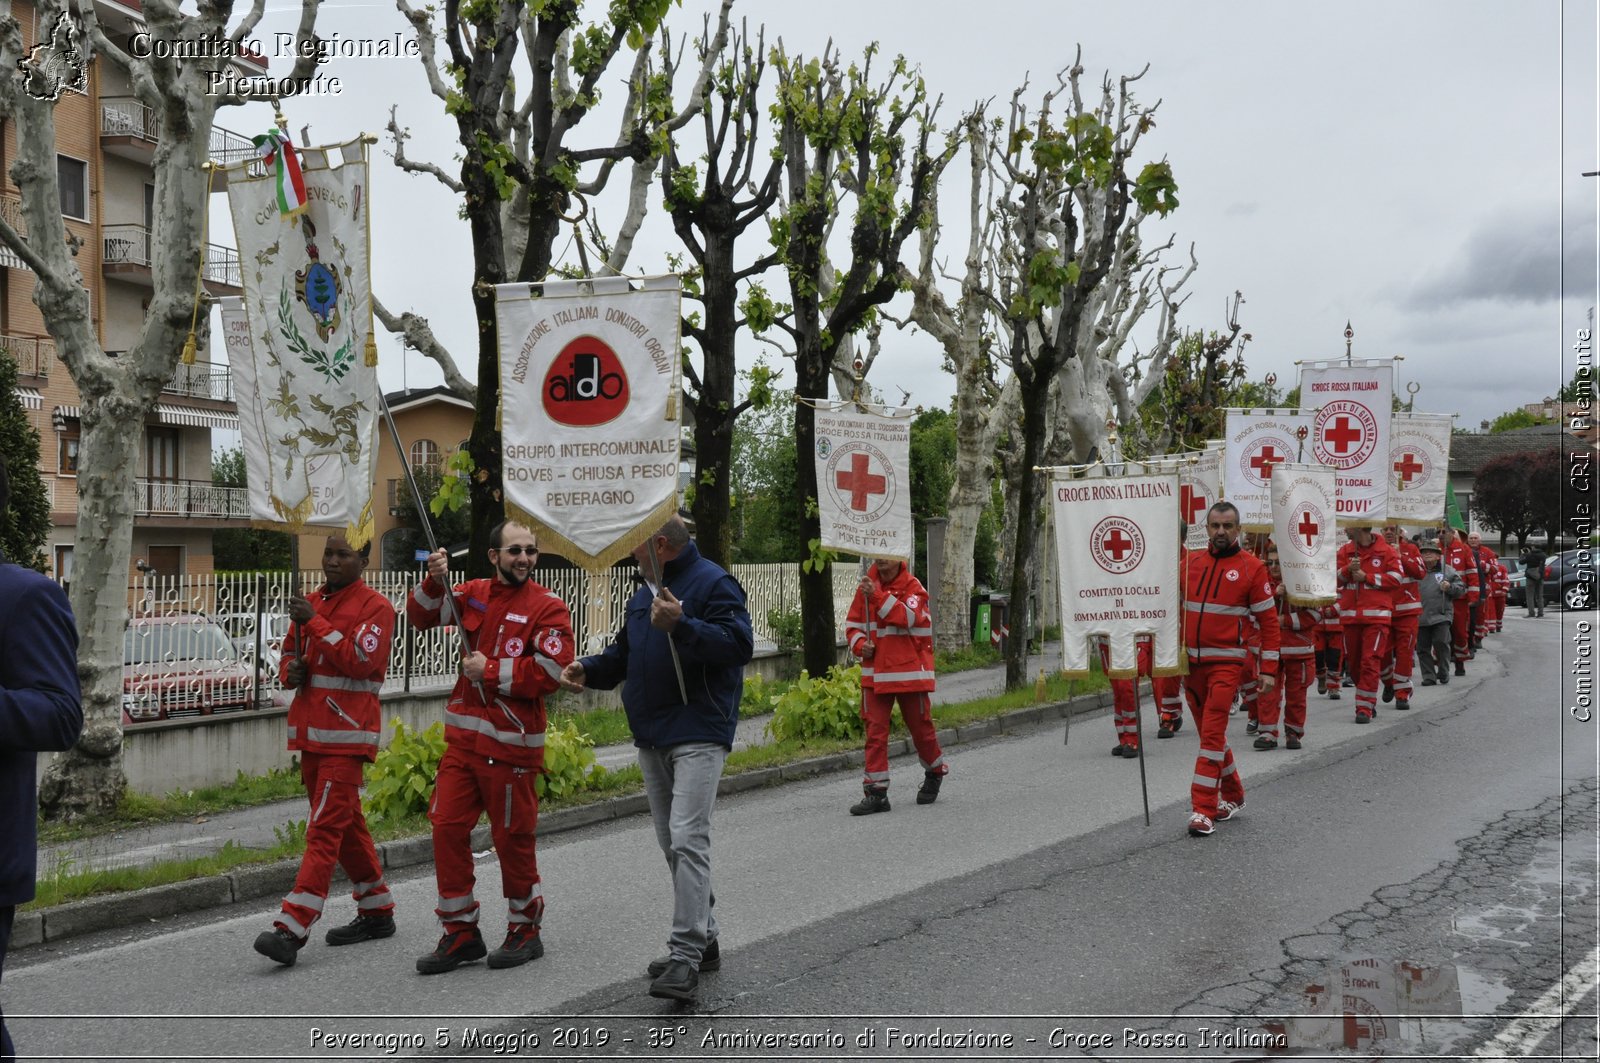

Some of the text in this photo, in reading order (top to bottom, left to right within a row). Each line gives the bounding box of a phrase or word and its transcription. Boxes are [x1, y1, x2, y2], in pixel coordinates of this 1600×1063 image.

[511, 306, 672, 384] ASSOCIAZIONE ITALIANA DONATORI ORGANI
[549, 354, 623, 402] aido
[1312, 381, 1378, 392] CROCE ROSSA ITALIANA
[866, 422, 876, 430] DEL
[1314, 403, 1374, 442] CONVENZIONE DI GINEVRA
[816, 427, 908, 442] CROCE ROSSA ITALIANA
[1234, 426, 1254, 443] CROCE
[1256, 422, 1277, 430] ROSSA
[506, 439, 676, 459] GRUPPO INTERCOMUNALE
[1318, 451, 1366, 468] 22 AGOSTO 1864
[508, 467, 553, 482] BOVES
[572, 466, 624, 480] CHIUSA
[632, 462, 676, 478] PESIO
[546, 490, 635, 506] PEVERAGNO
[1058, 482, 1171, 502] CROCE ROSSA ITALIANA
[1336, 488, 1343, 496] di
[1098, 526, 1106, 534] DI
[1104, 520, 1128, 528] GINEVRA
[839, 532, 888, 548] MORETTA
[866, 529, 896, 538] LOCALE
[1094, 533, 1112, 568] CONVENZIONE
[1134, 534, 1142, 558] AGOSTO
[1080, 586, 1160, 598] COMITATO LOCALE
[1115, 599, 1124, 608] DI
[1074, 610, 1166, 622] SOMMARIVA DEL BOSCO
